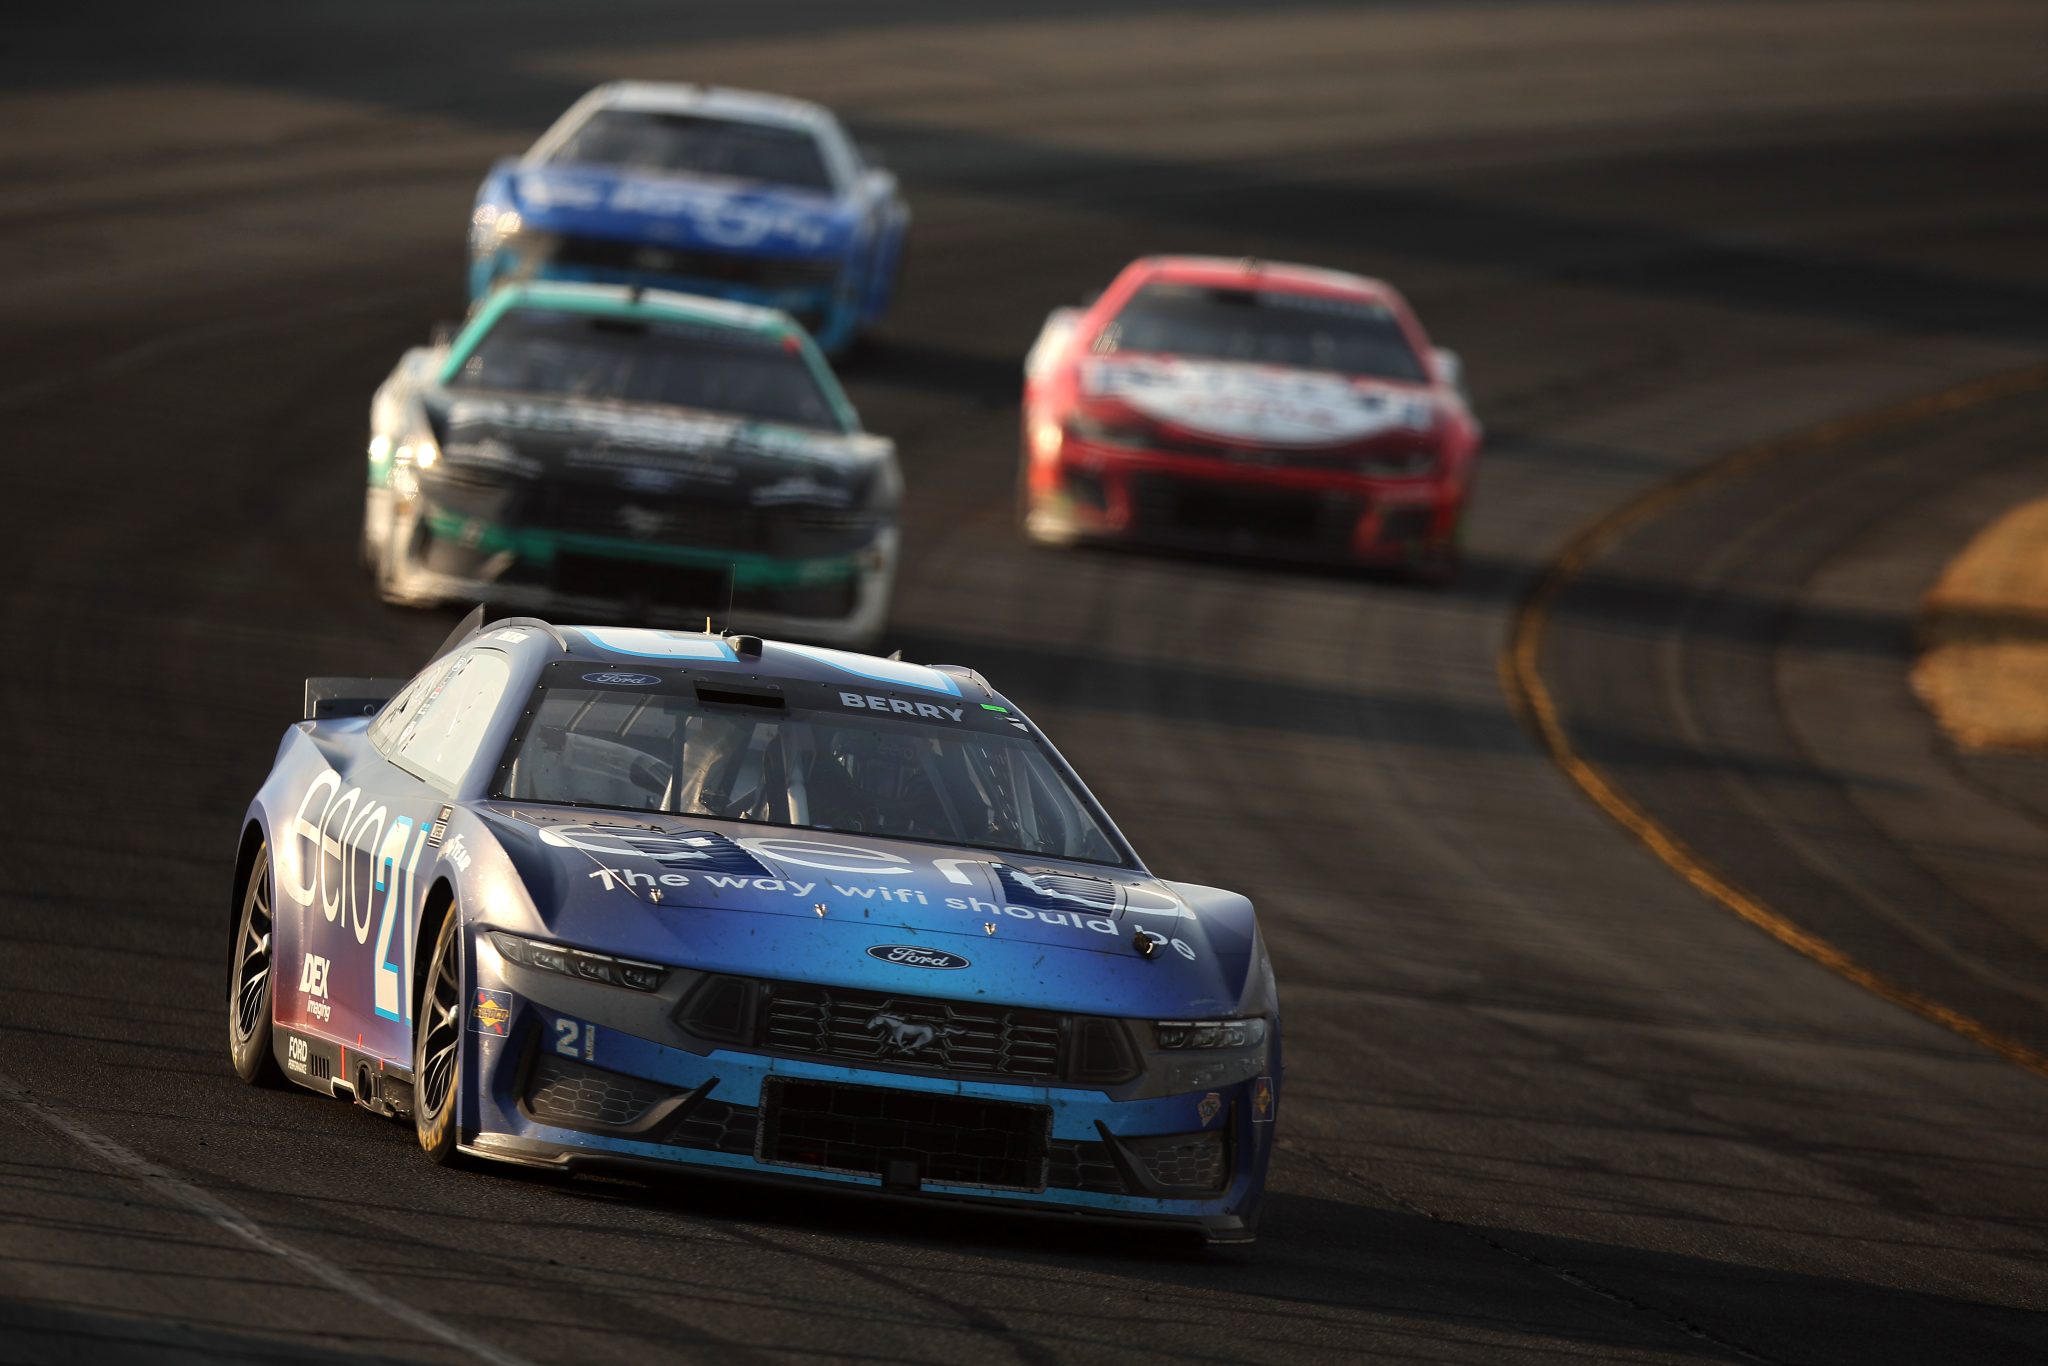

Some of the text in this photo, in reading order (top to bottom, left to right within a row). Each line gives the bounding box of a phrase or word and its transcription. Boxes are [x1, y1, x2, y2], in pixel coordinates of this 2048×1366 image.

[839, 691, 963, 722] BERRY
[283, 768, 387, 943] eero
[538, 823, 1197, 920] eero
[589, 867, 1196, 961] The way wifi should be
[298, 952, 331, 999] DEX
[886, 946, 951, 968] Ford
[306, 994, 332, 1023] imaging
[288, 1036, 308, 1063] FORD
